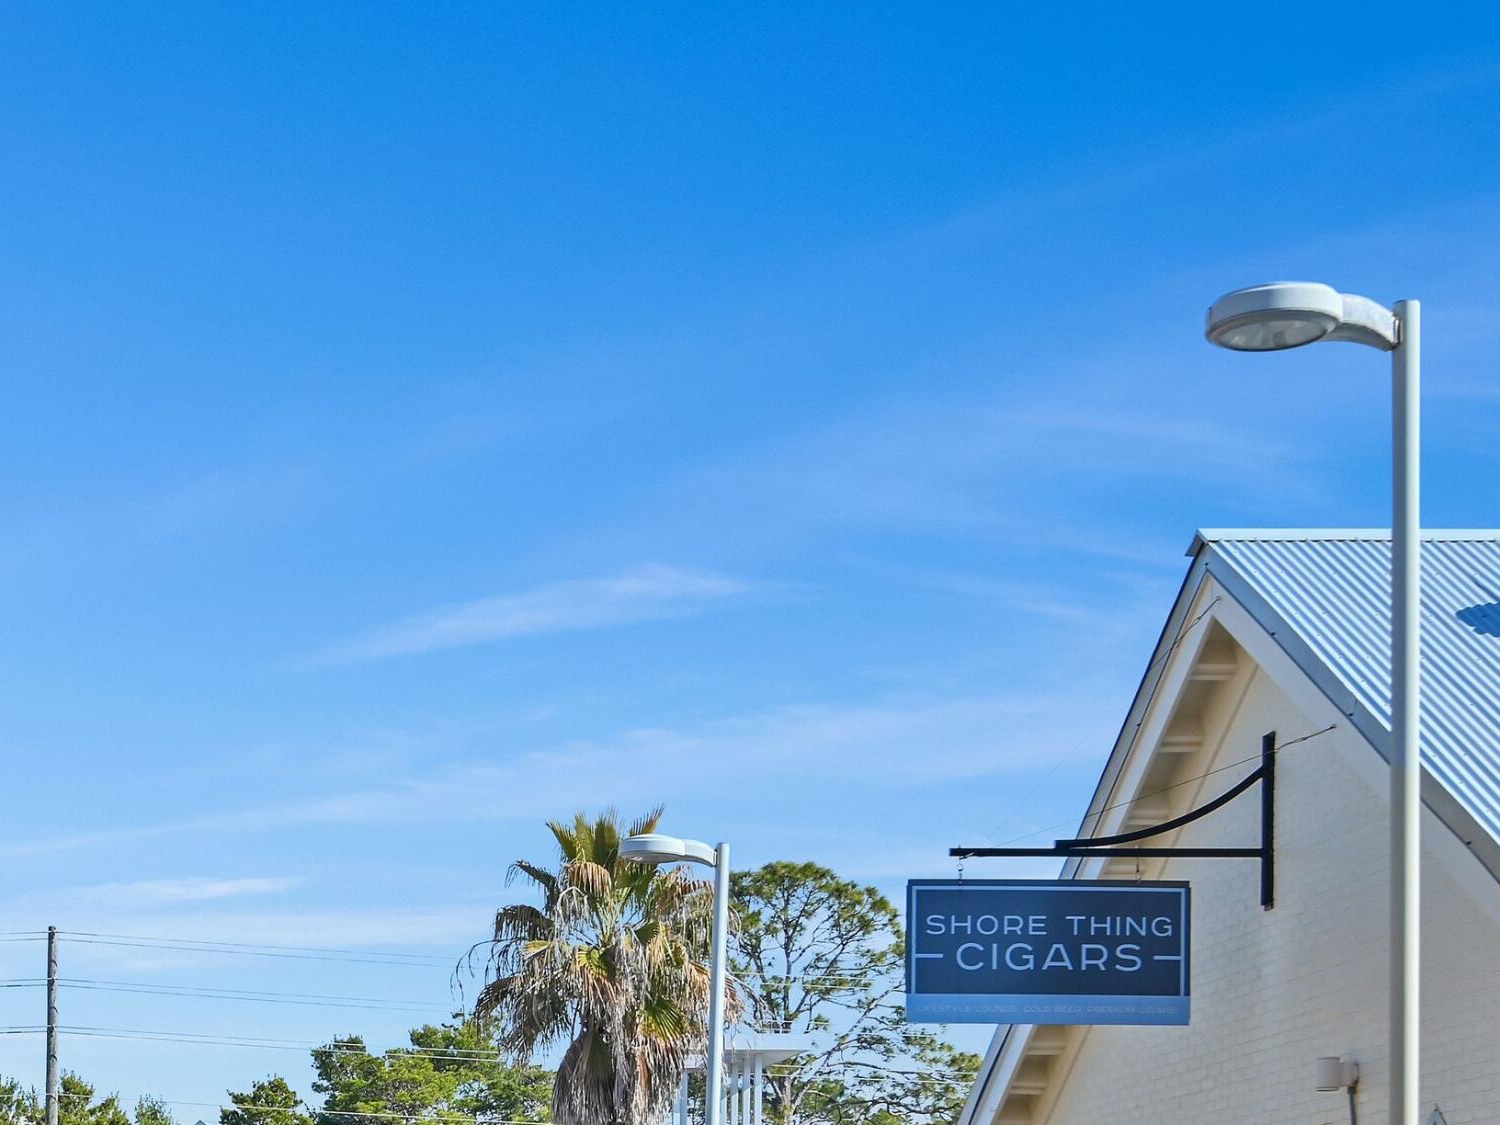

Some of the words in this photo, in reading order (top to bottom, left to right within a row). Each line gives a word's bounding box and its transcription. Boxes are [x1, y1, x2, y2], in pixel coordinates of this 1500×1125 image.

[925, 914, 1048, 936] SHORE
[1065, 915, 1173, 937] THING
[955, 942, 1142, 972] CIGARS
